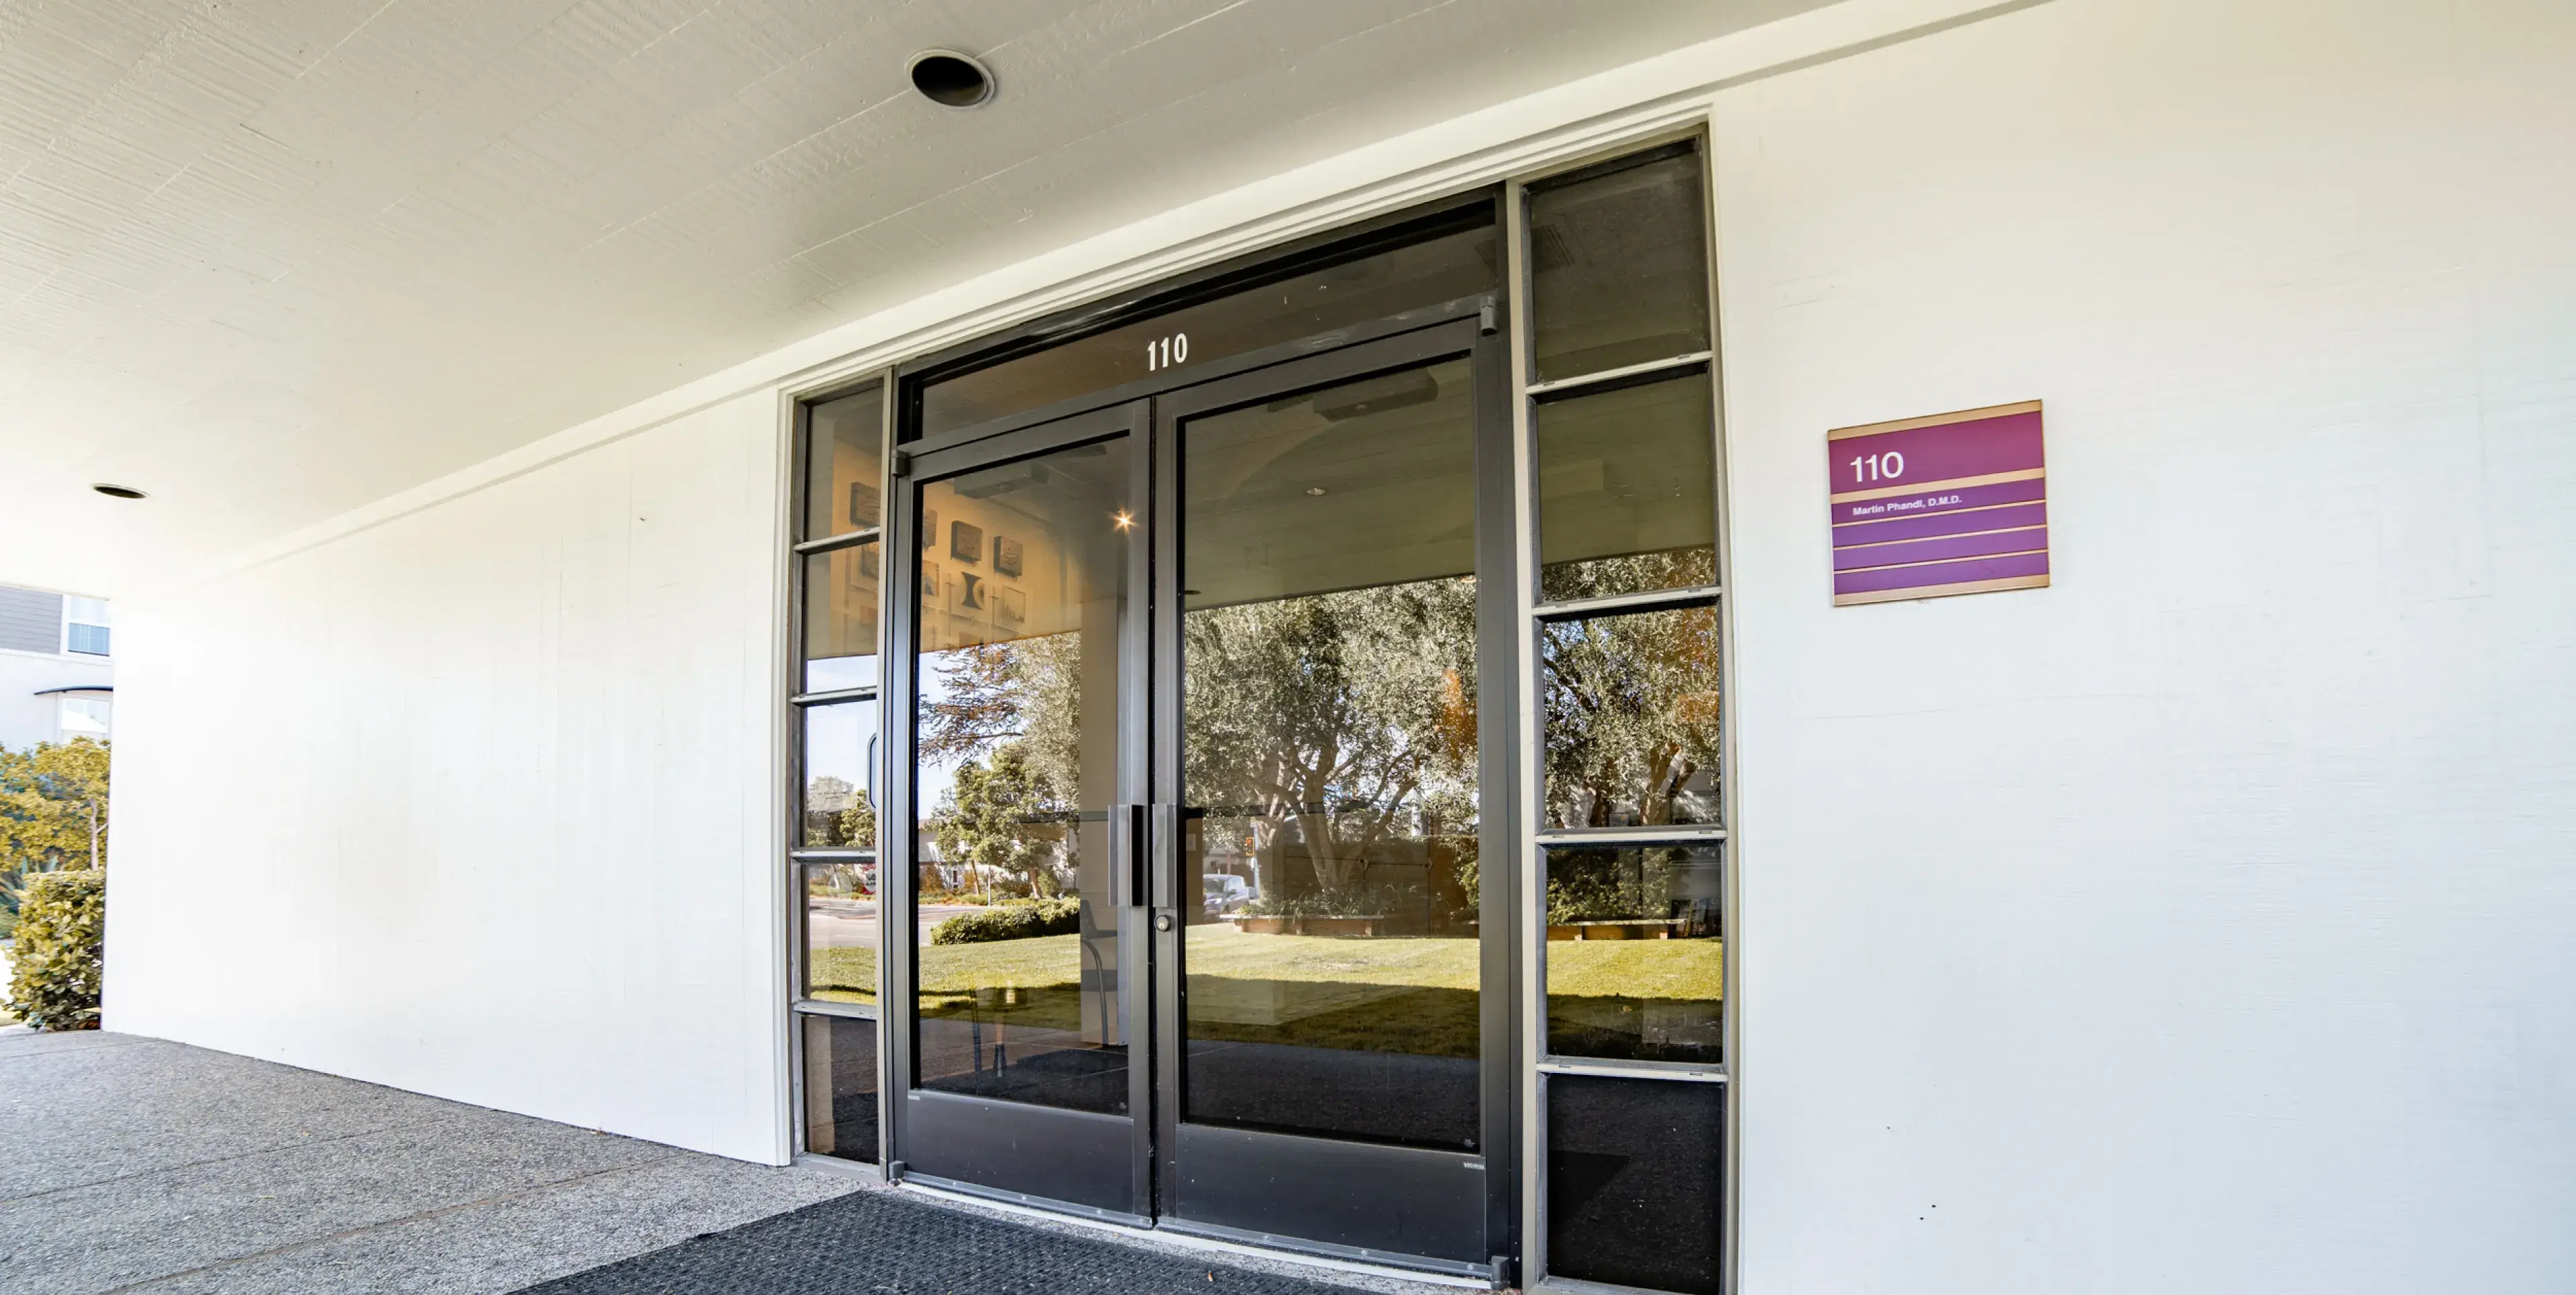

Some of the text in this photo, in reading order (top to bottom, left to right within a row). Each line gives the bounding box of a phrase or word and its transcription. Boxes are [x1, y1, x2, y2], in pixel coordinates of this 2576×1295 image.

[1148, 333, 1187, 371] 110
[1849, 451, 1904, 482] 110
[1853, 505, 1885, 515] Martin
[1928, 495, 1962, 507] D.M.D.
